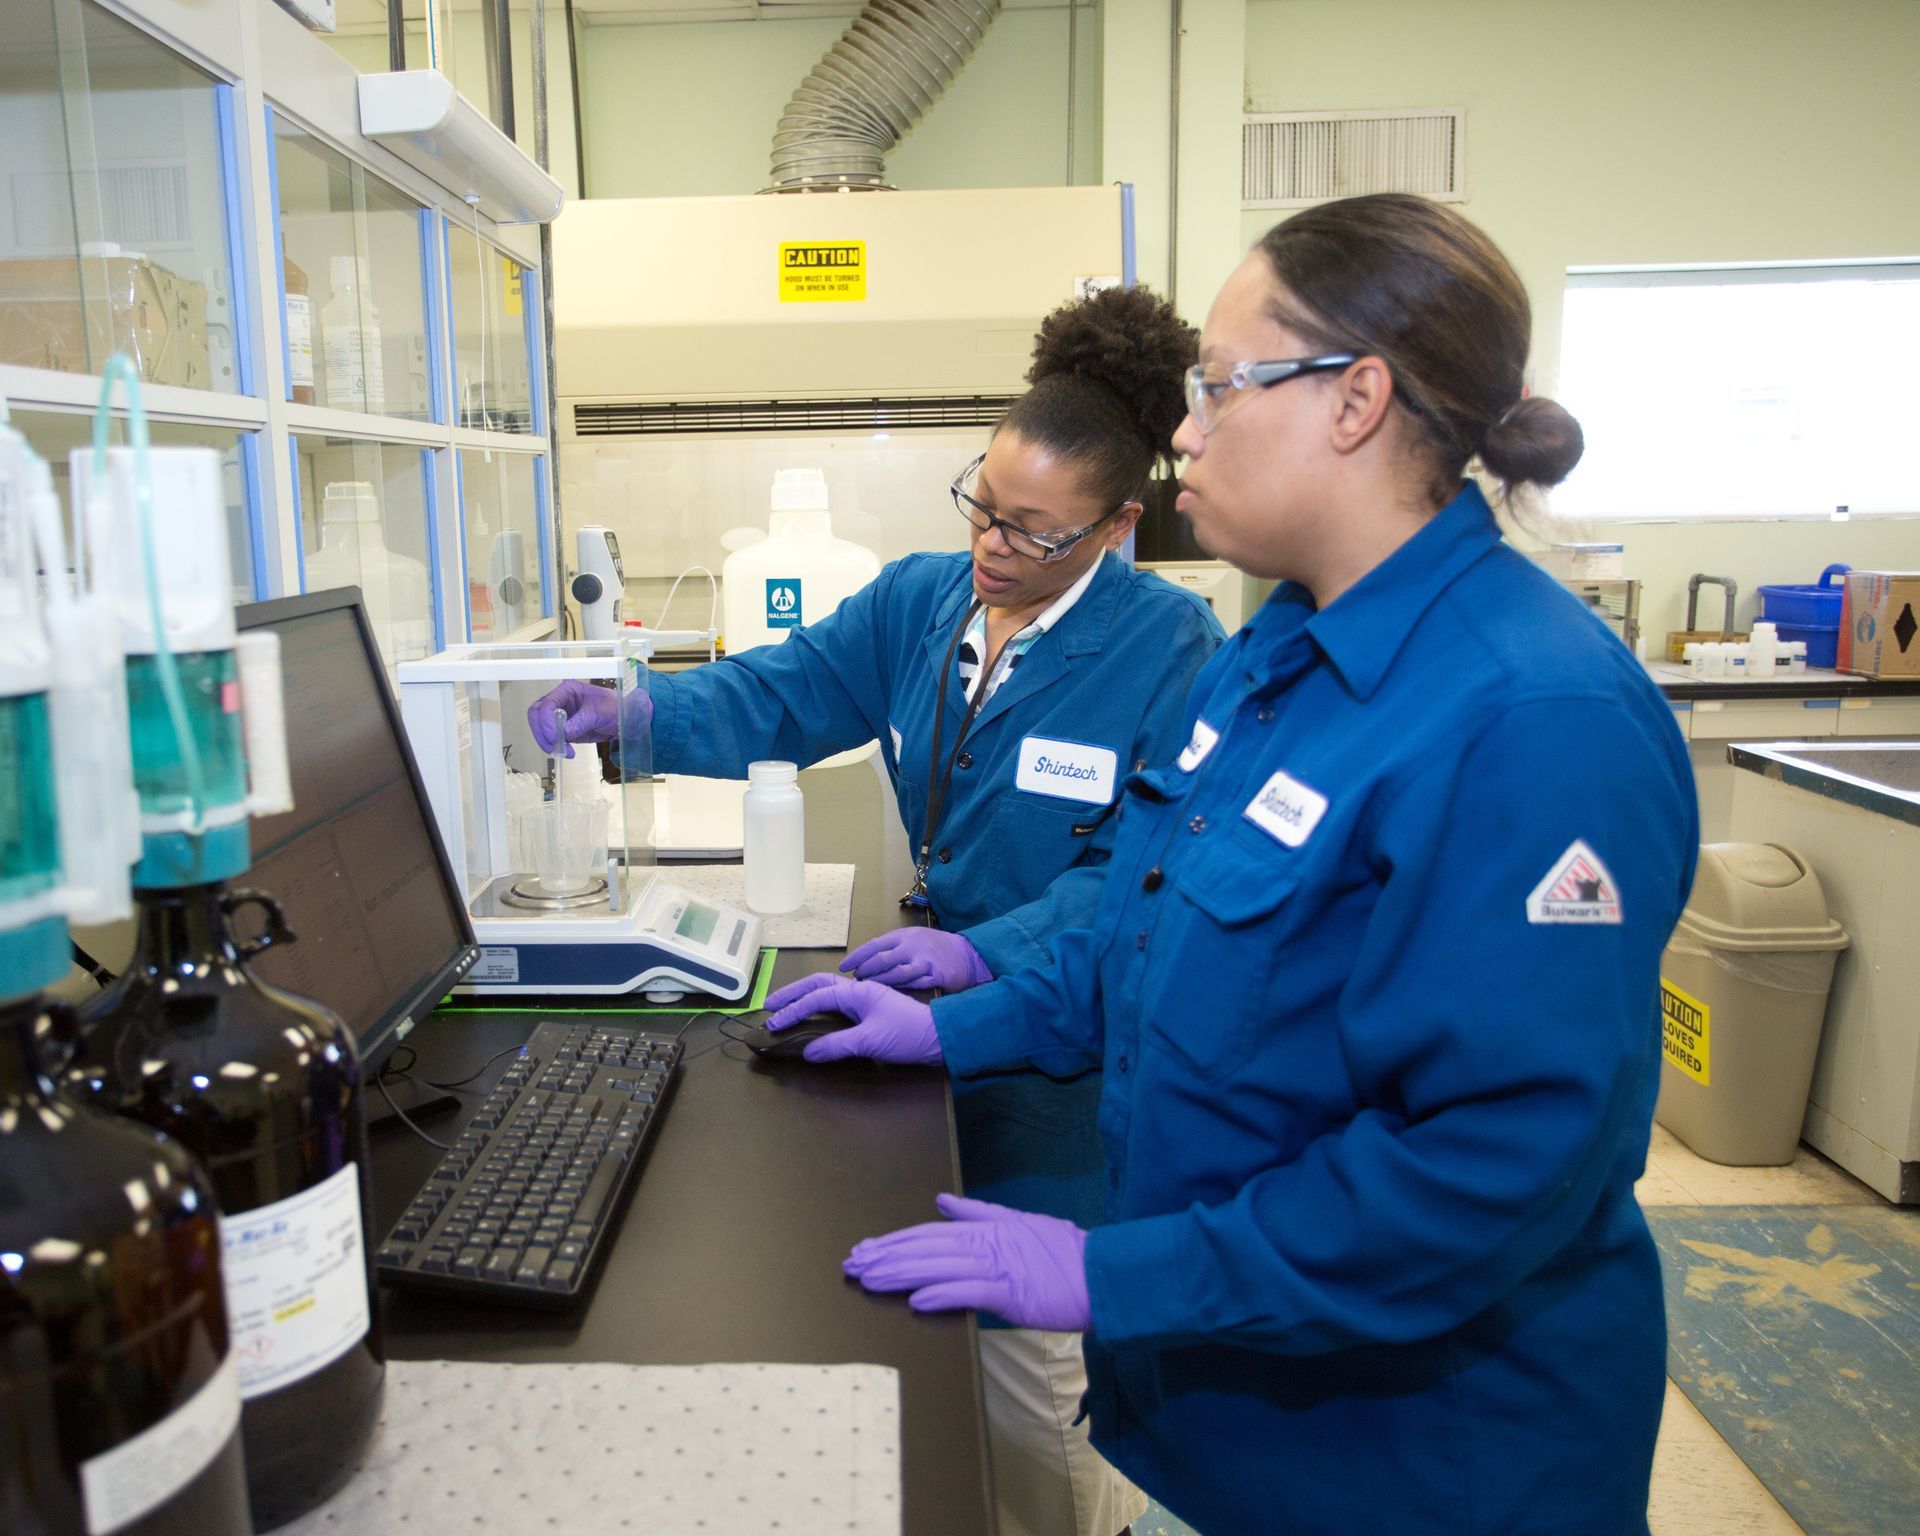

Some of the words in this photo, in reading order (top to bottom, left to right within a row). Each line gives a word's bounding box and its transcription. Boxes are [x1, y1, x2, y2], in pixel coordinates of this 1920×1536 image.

[786, 248, 858, 266] CAUTION
[785, 275, 802, 283] HOOD
[835, 274, 860, 282] TURNED
[1034, 755, 1098, 781] Shintech
